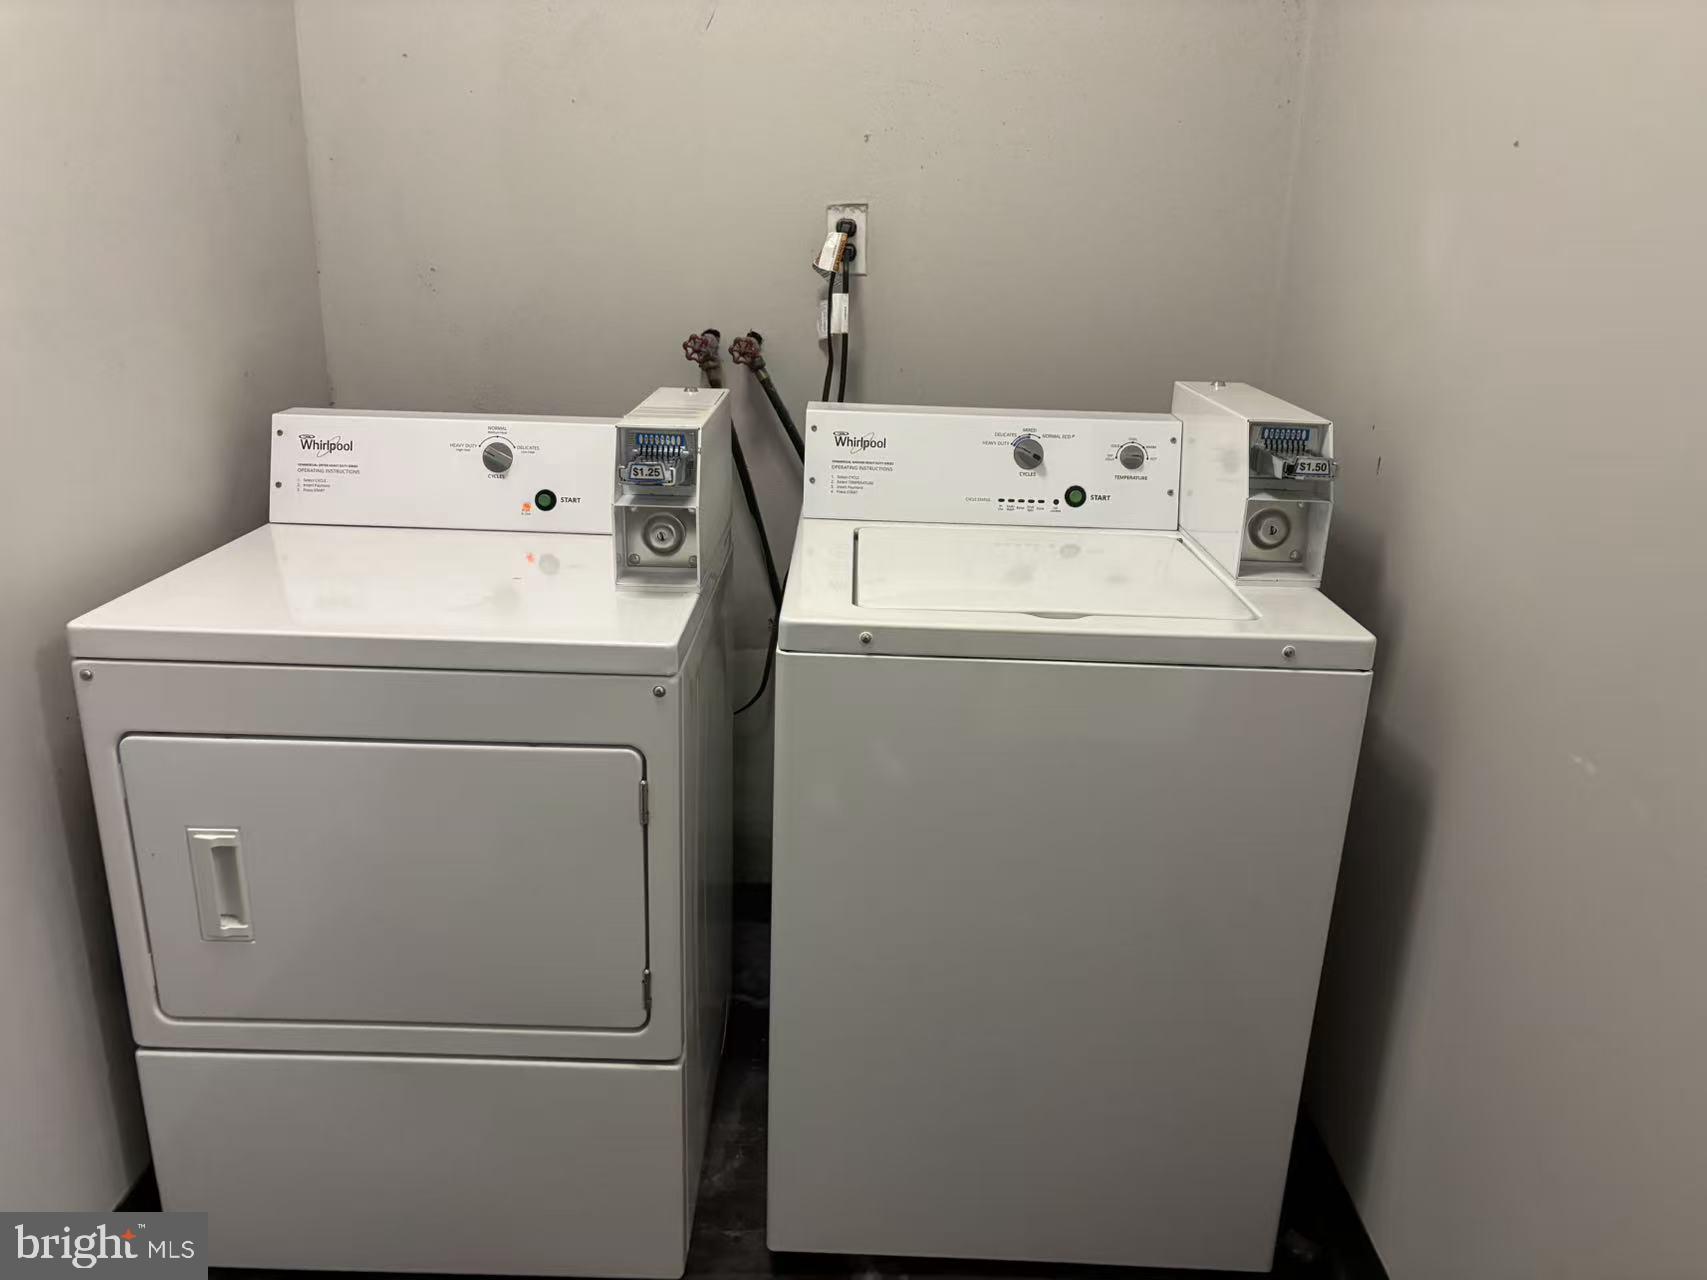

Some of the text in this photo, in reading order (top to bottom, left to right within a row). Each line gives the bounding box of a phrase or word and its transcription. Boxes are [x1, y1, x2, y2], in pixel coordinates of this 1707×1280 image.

[300, 438, 354, 454] Whirlpool
[834, 436, 887, 451] Whirlpool
[632, 466, 661, 477] $1.25
[1299, 462, 1327, 472] $1.50
